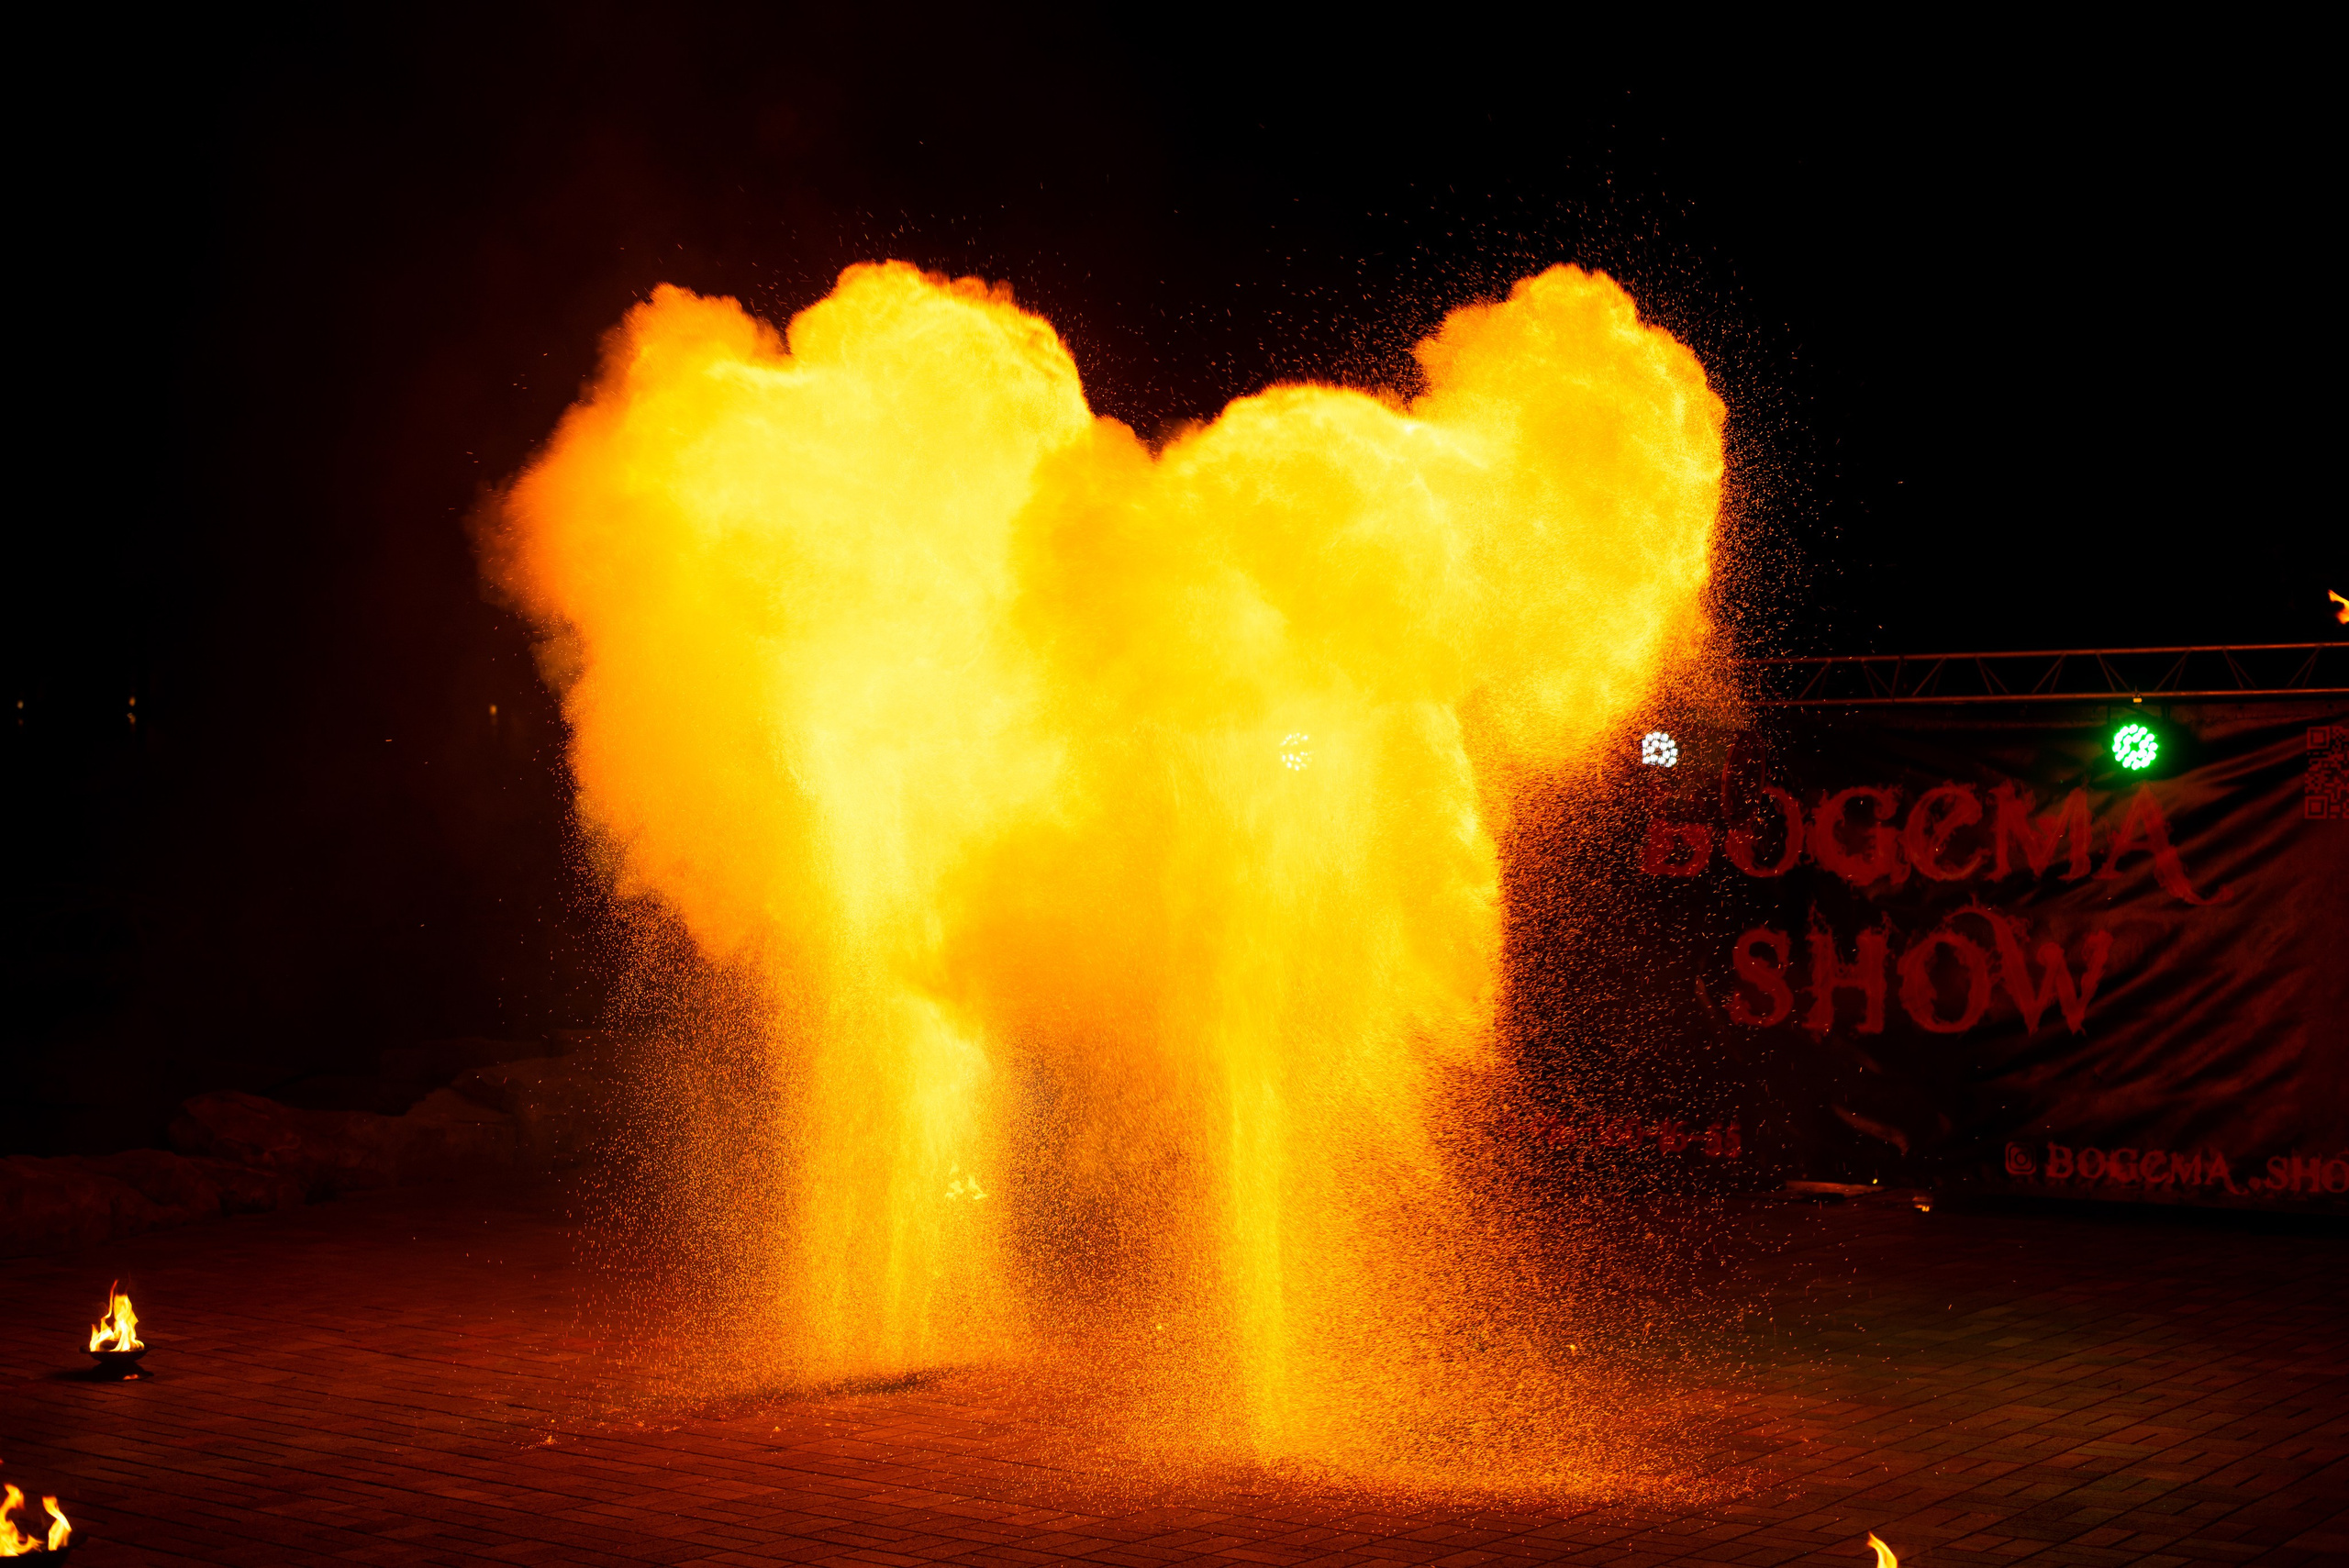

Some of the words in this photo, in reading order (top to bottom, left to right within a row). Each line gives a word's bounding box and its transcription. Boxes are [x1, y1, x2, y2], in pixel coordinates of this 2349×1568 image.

[1641, 780, 2234, 906] BOGEMA
[1729, 899, 2112, 1042] SHOW
[2045, 1141, 2349, 1195] BOGEMA.SHO
